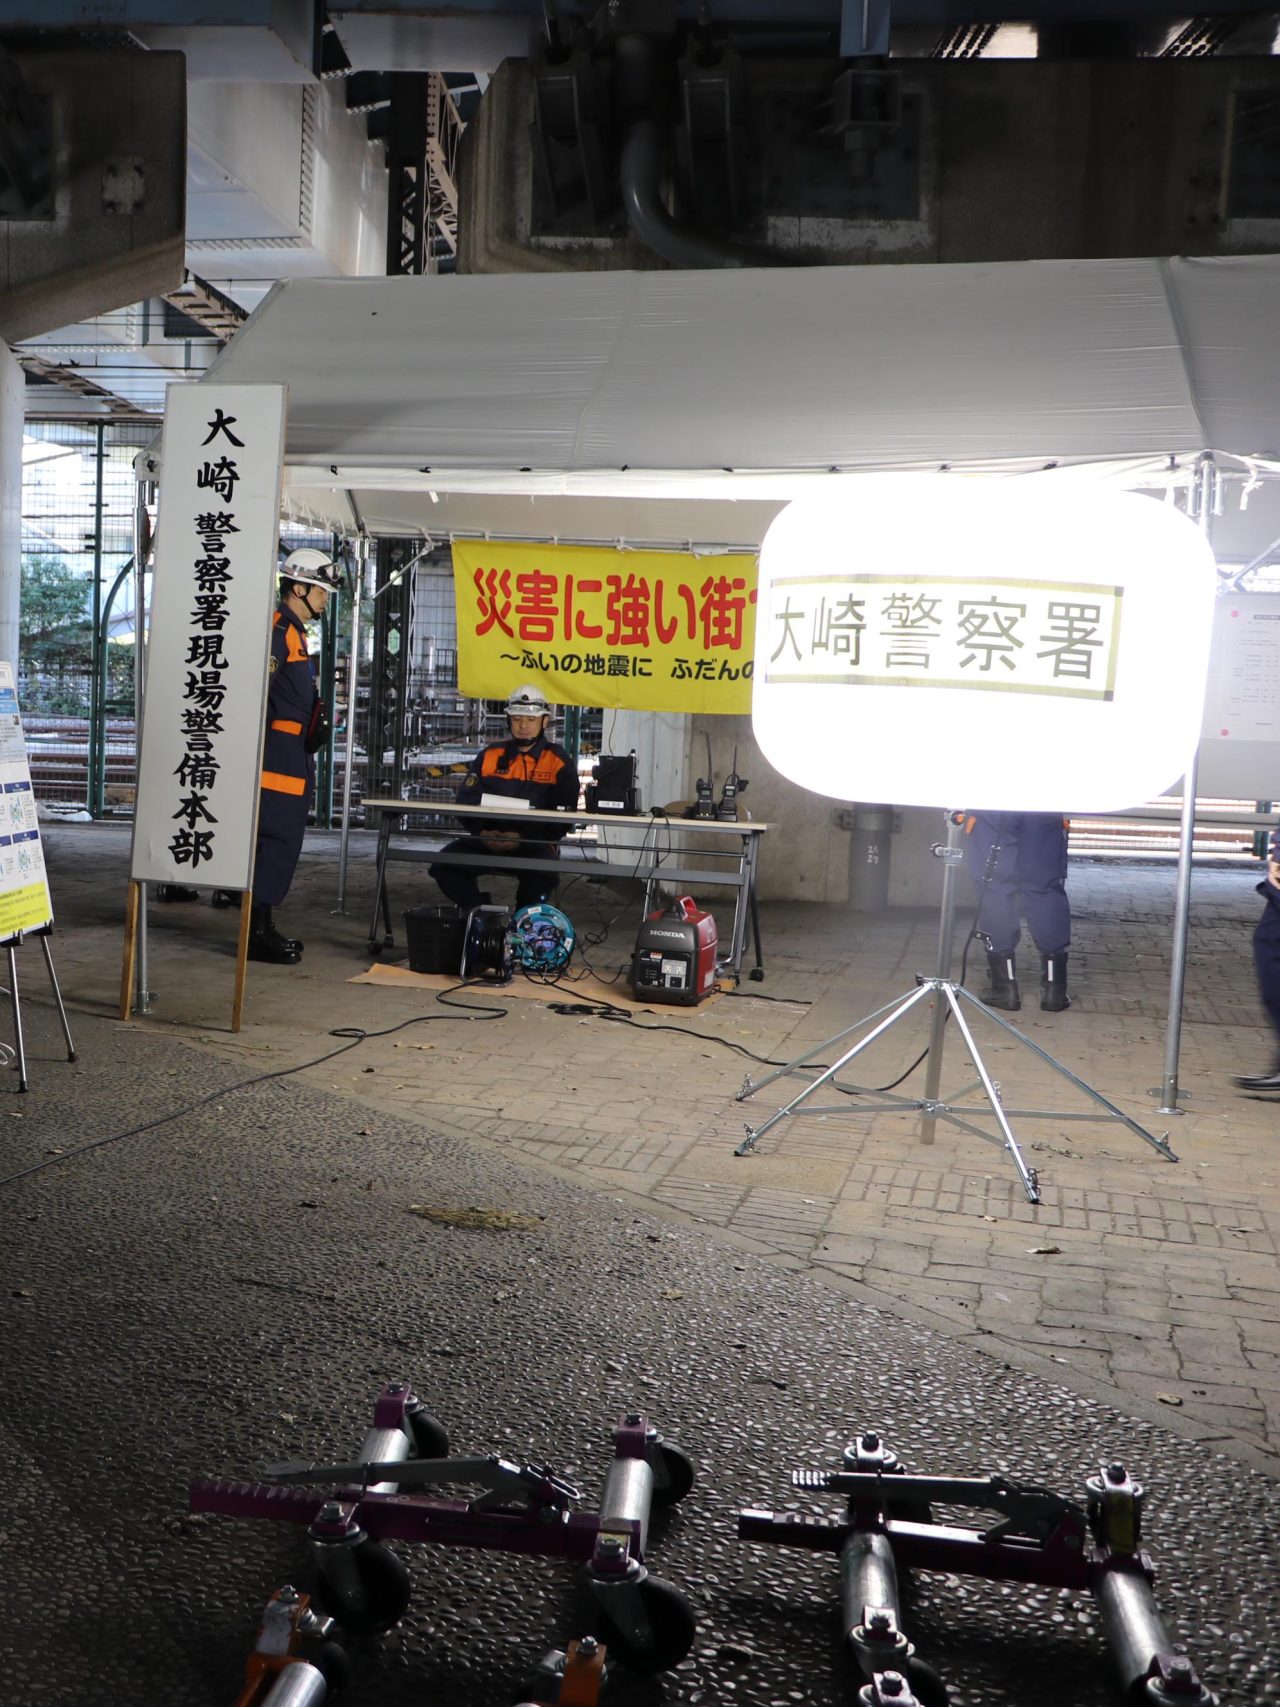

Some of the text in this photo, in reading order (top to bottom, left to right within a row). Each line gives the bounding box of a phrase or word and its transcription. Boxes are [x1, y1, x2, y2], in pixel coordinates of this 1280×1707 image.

[167, 408, 245, 869] 大崎警察署現場警備本部
[474, 567, 757, 650] 災害に強い街
[770, 592, 1104, 680] 大崎警察署
[649, 929, 685, 938] HONDA
